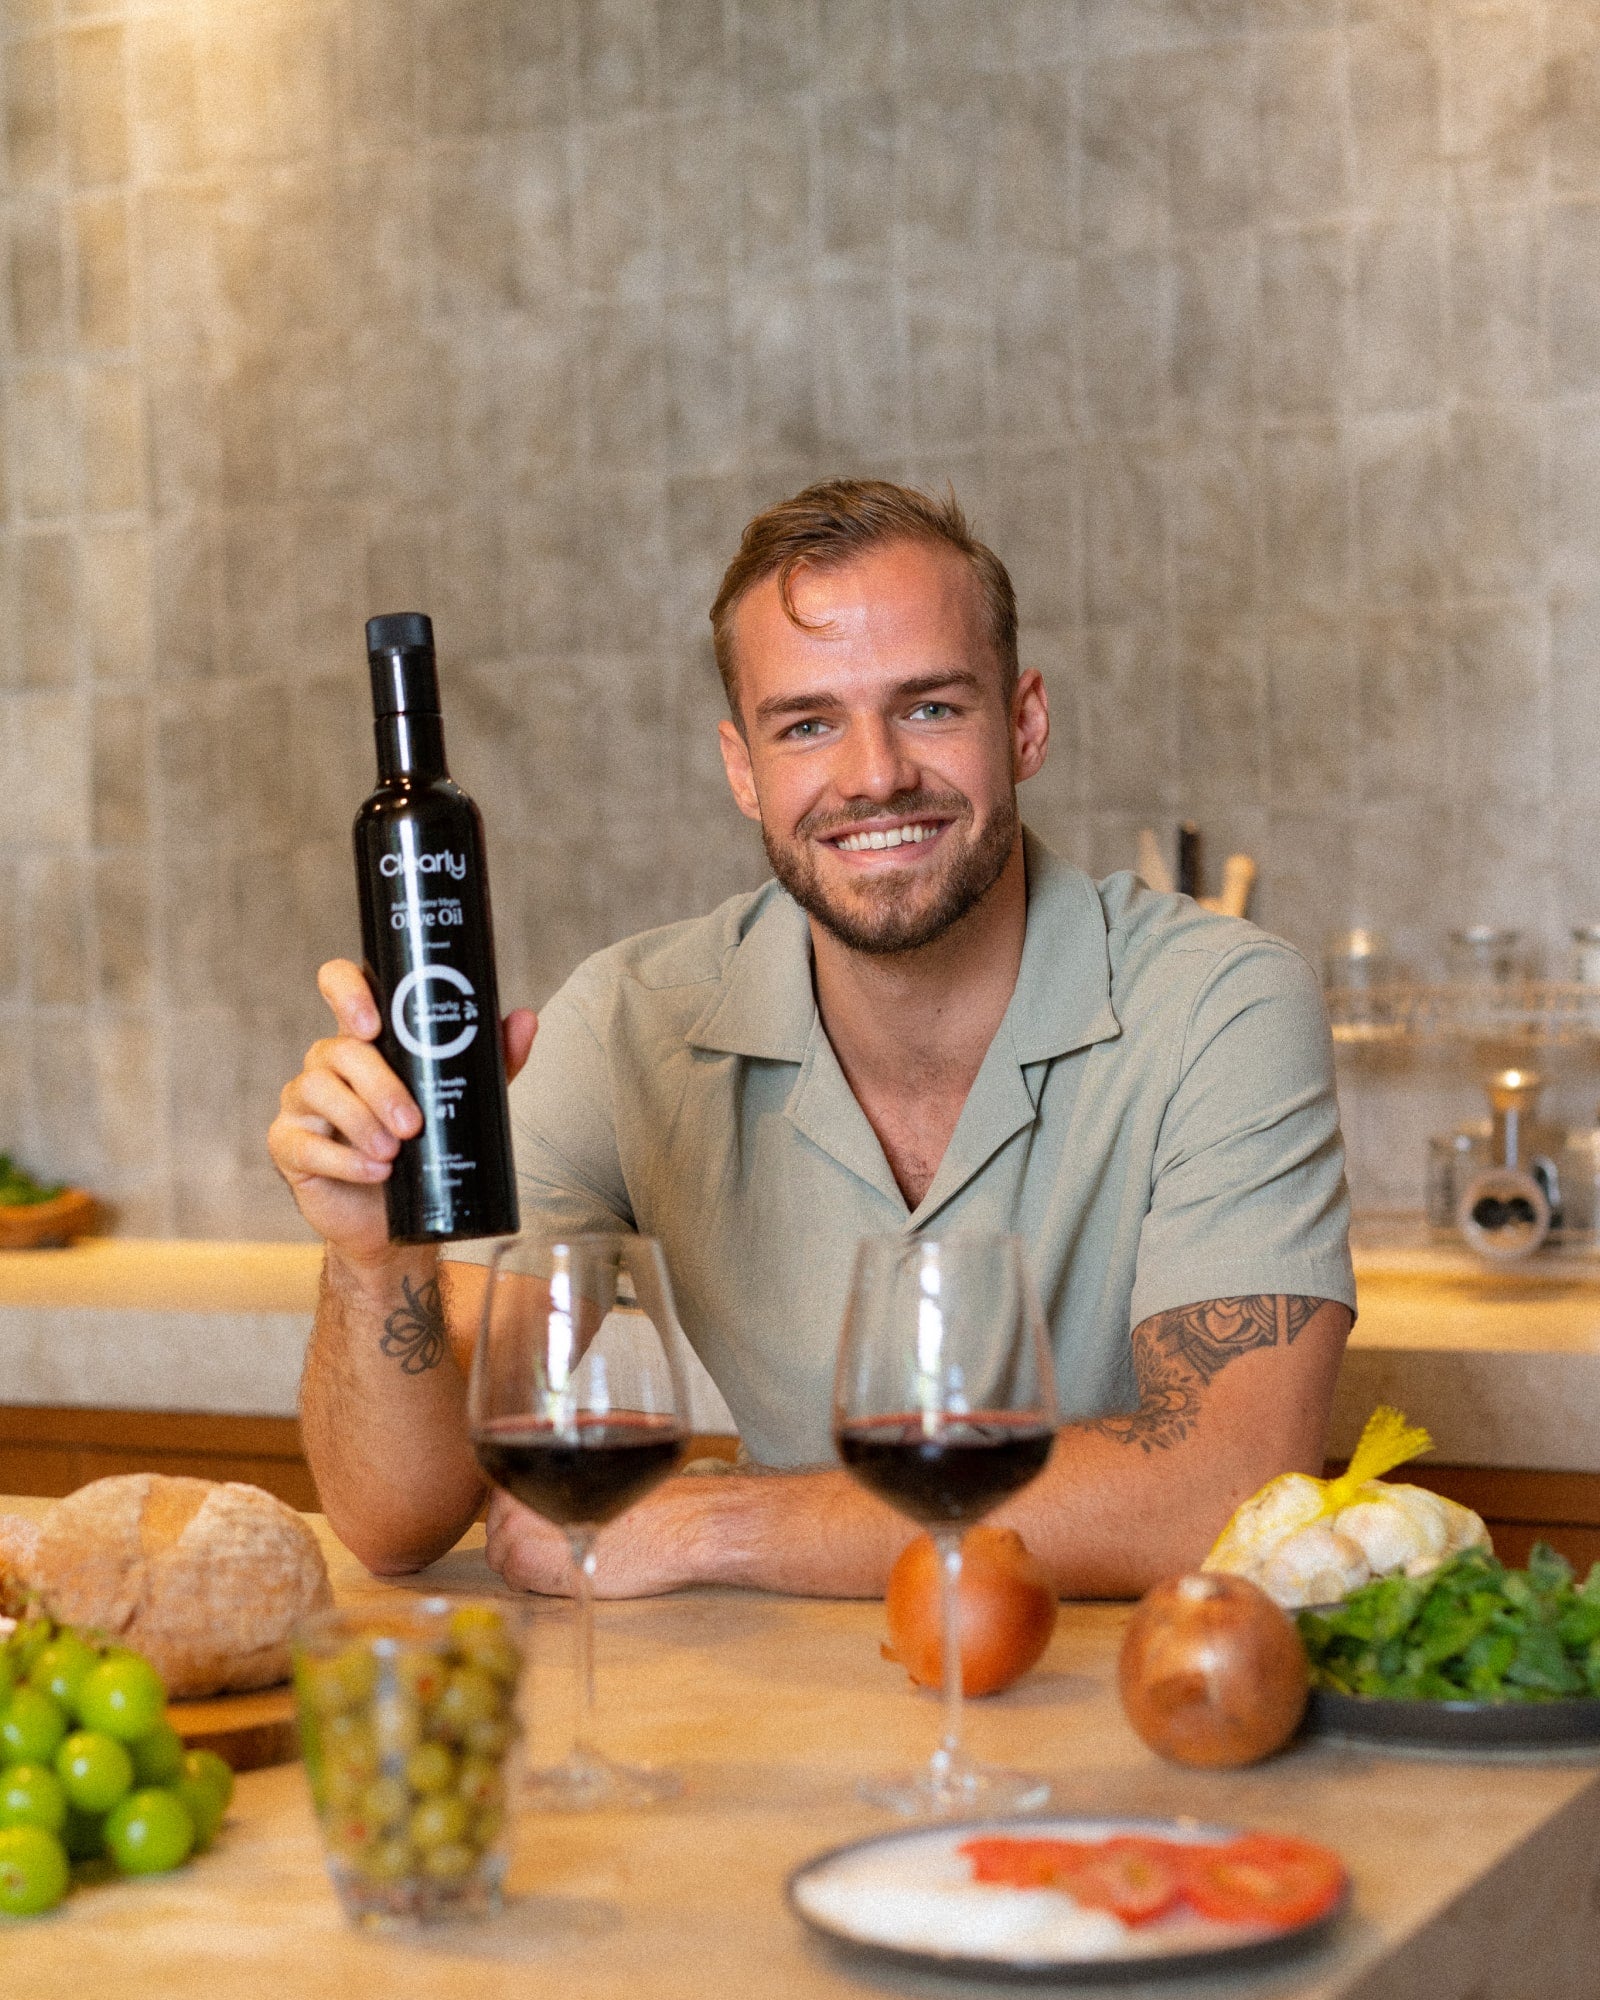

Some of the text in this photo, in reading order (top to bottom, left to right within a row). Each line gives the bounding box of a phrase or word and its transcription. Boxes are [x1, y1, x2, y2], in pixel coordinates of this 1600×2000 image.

[380, 849, 466, 880] Clarly
[391, 907, 463, 931] Olve Oil
